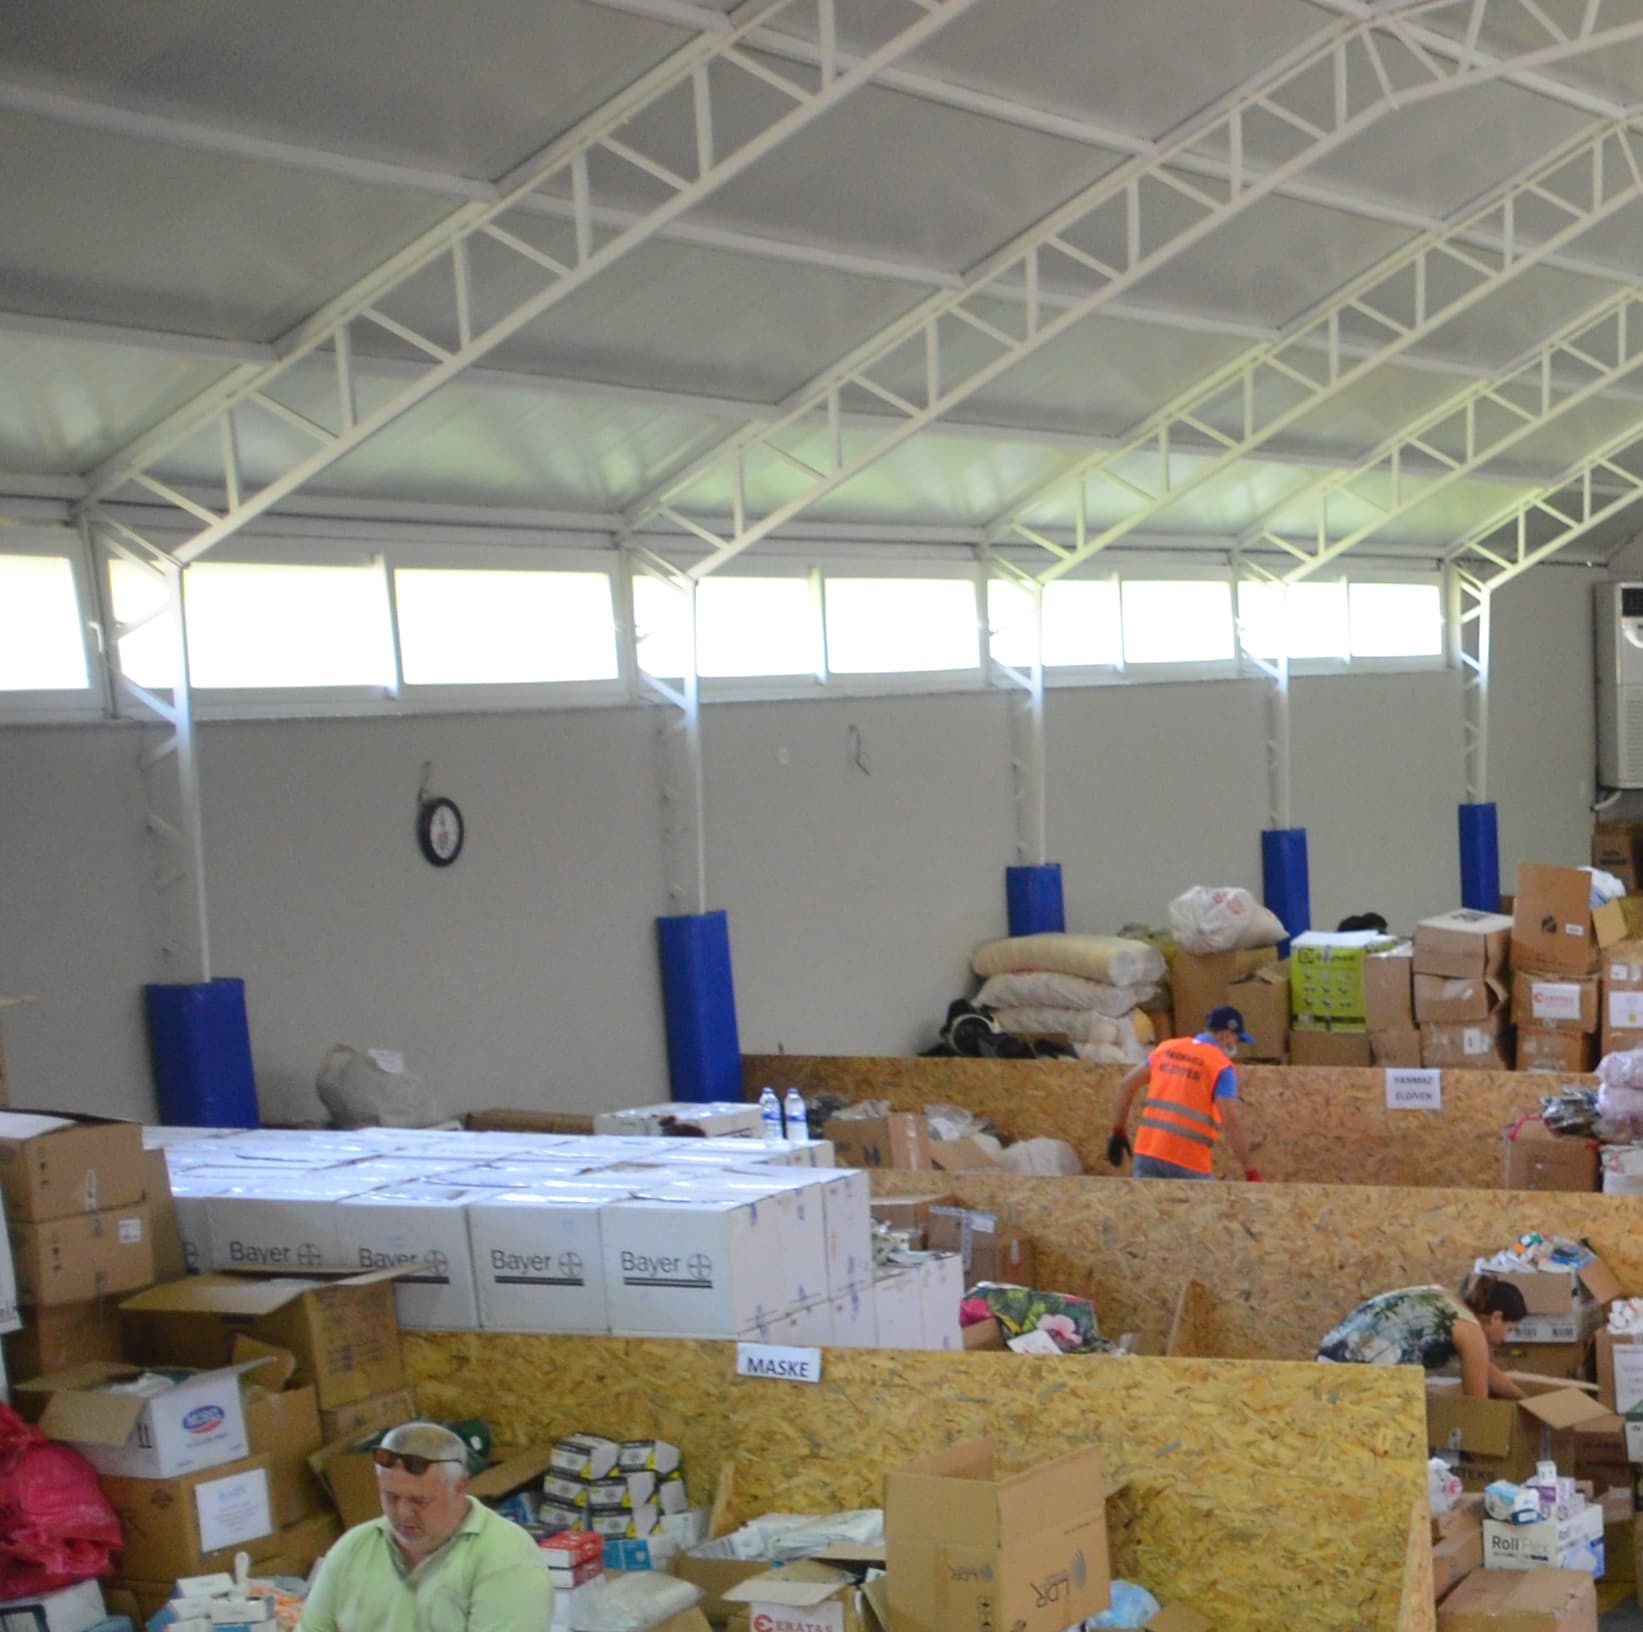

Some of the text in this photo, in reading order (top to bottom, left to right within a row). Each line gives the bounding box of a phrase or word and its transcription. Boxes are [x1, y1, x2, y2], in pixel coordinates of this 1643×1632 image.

[230, 1241, 291, 1264] Bayer
[359, 1247, 419, 1268] Bayer
[491, 1249, 552, 1273] Bayer
[621, 1250, 682, 1274] Bayer
[746, 1357, 809, 1378] MASKE
[1492, 1536, 1519, 1551] Roll
[1030, 1574, 1070, 1608] LDR
